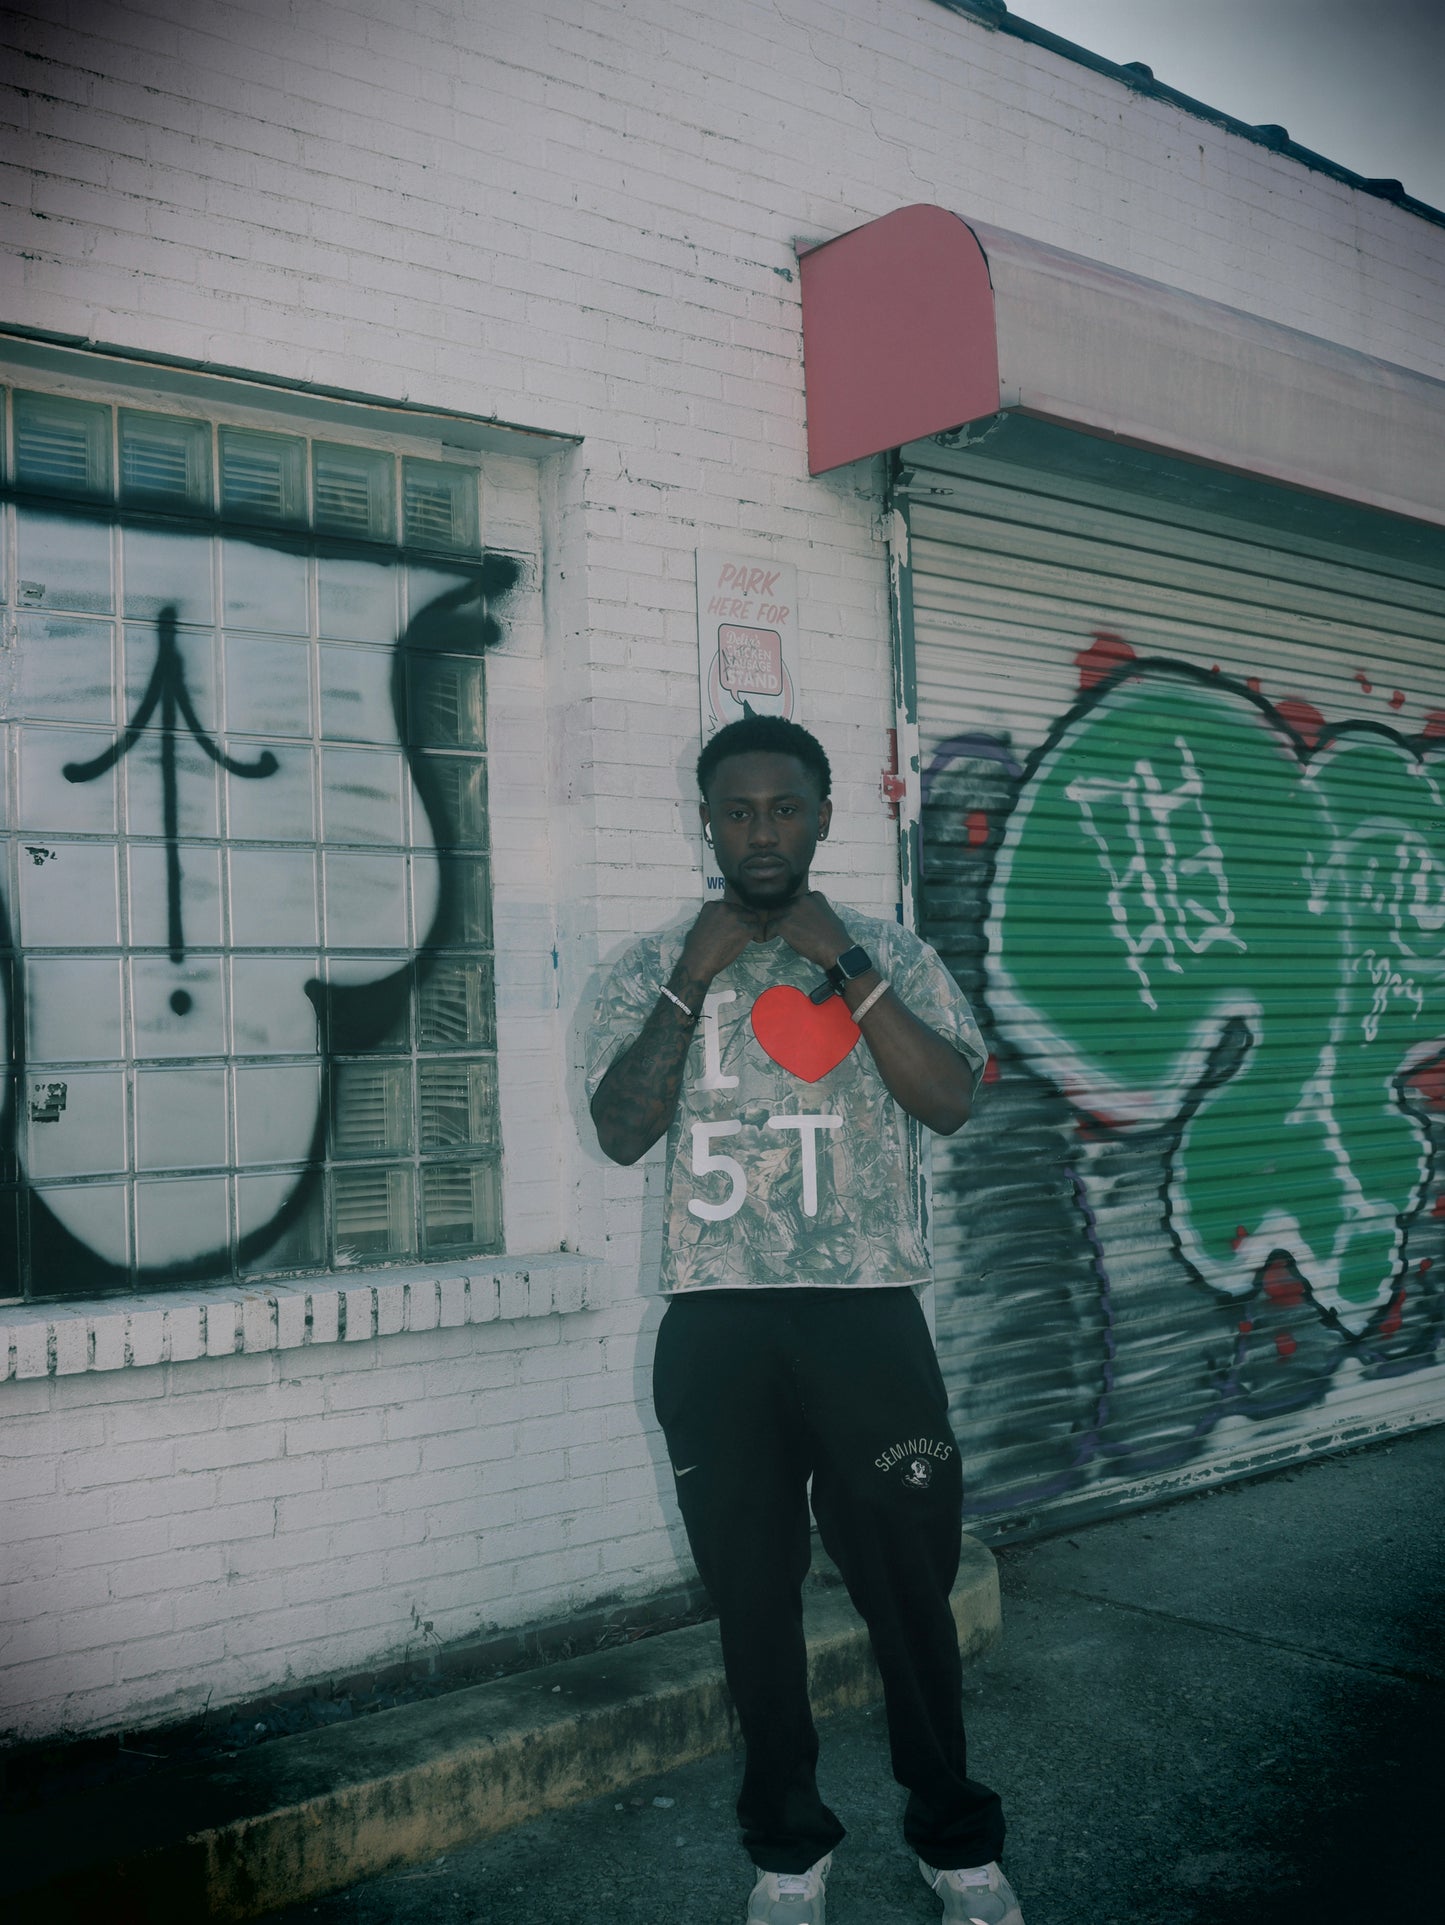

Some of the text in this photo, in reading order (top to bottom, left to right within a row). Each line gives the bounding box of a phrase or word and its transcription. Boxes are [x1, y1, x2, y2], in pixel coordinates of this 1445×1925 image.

[718, 562, 781, 597] PARK
[707, 596, 790, 625] HERE FOR
[727, 645, 772, 661] CHICKEN
[727, 655, 772, 672] SAUSAGE
[728, 668, 778, 689] STAND
[694, 990, 739, 1090] I
[874, 1438, 953, 1472] SEMINOLES
